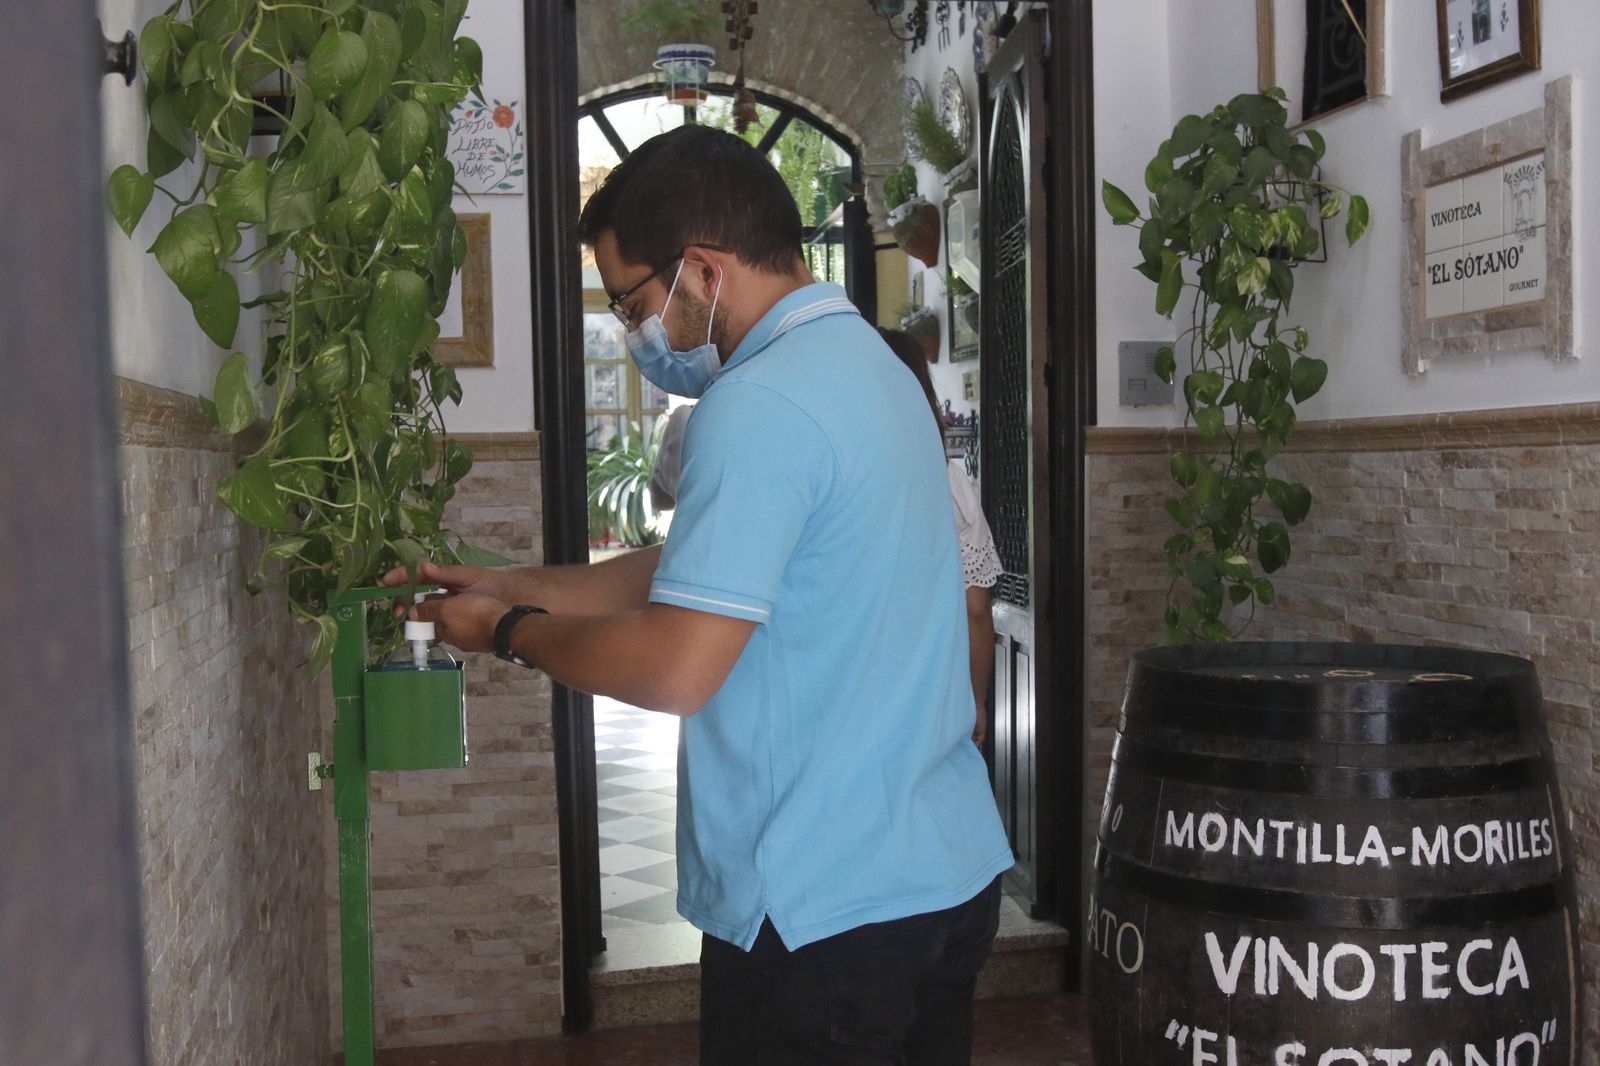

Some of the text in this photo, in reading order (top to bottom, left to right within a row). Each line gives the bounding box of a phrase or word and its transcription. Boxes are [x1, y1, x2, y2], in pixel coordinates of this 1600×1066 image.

[452, 137, 495, 154] LIBRE
[466, 152, 486, 161] DE
[455, 160, 495, 184] HUMOS
[1431, 202, 1482, 227] VINOTECA
[1509, 278, 1539, 292] GOURMET
[1165, 810, 1553, 866] MONTILLA-MORILES
[1205, 931, 1530, 1001] VINOTECA
